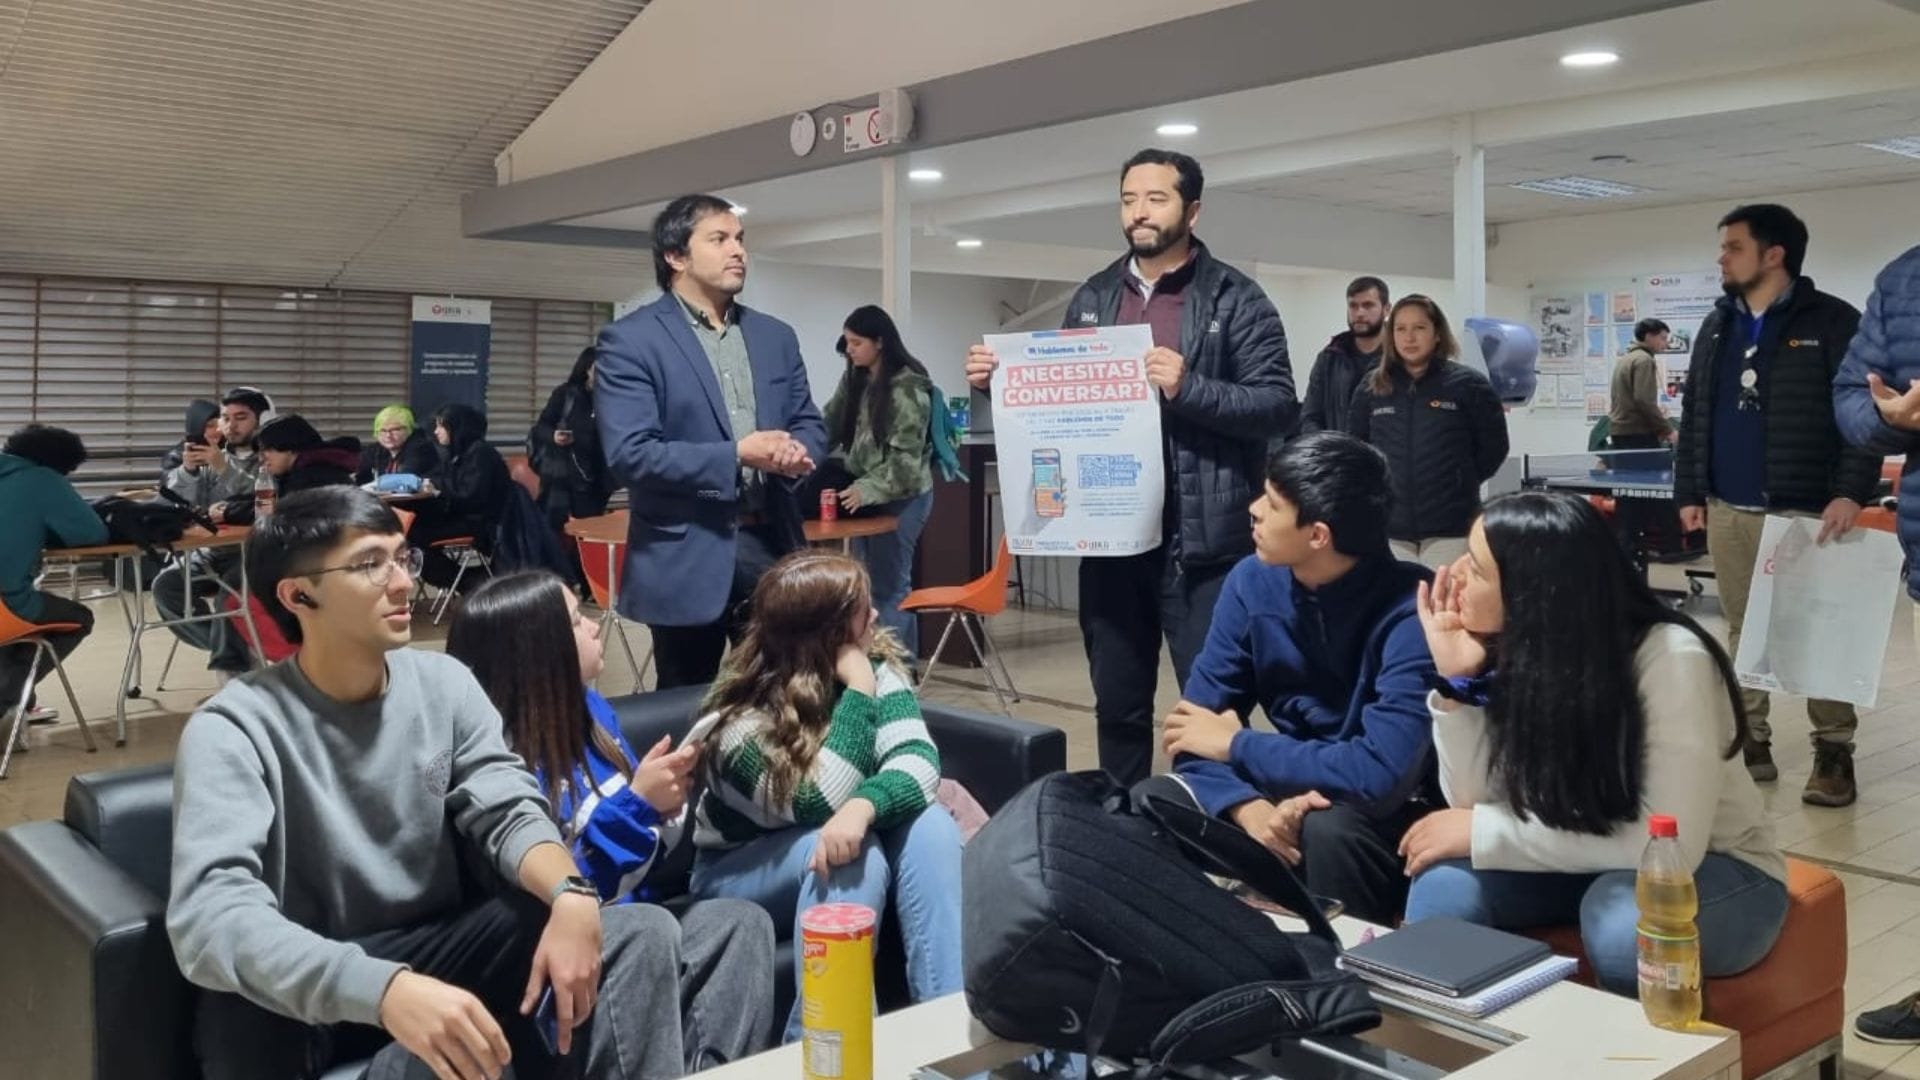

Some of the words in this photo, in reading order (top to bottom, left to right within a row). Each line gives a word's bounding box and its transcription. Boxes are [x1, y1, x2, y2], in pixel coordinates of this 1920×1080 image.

[1038, 346, 1076, 355] Hablemos
[1078, 345, 1088, 353] de
[1010, 361, 1136, 387] ¿NECESITAS
[1005, 383, 1144, 405] CONVERSAR?
